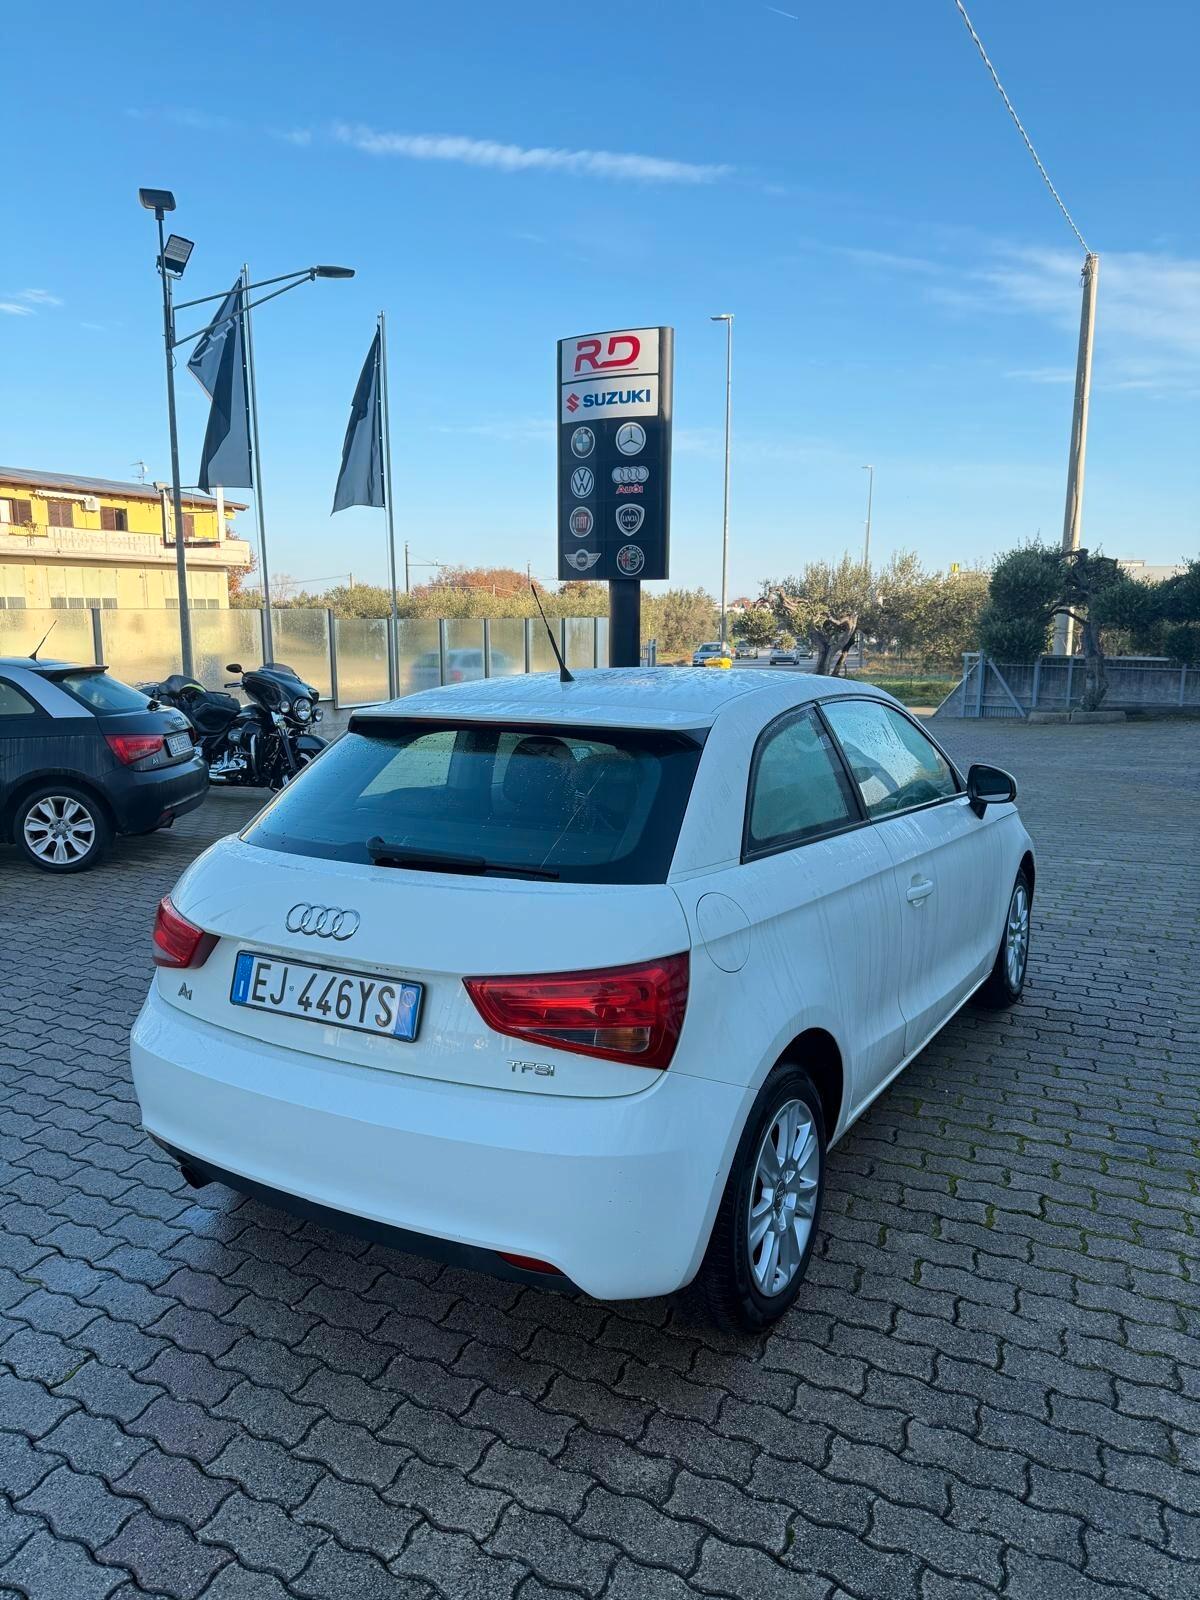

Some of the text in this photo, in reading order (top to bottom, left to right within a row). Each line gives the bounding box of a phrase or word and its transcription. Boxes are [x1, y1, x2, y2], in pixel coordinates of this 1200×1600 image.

[575, 336, 640, 372] RD
[583, 389, 651, 408] SUZUKI
[616, 484, 643, 494] Audi
[178, 982, 193, 1001] A1
[506, 1060, 555, 1077] TFSI
